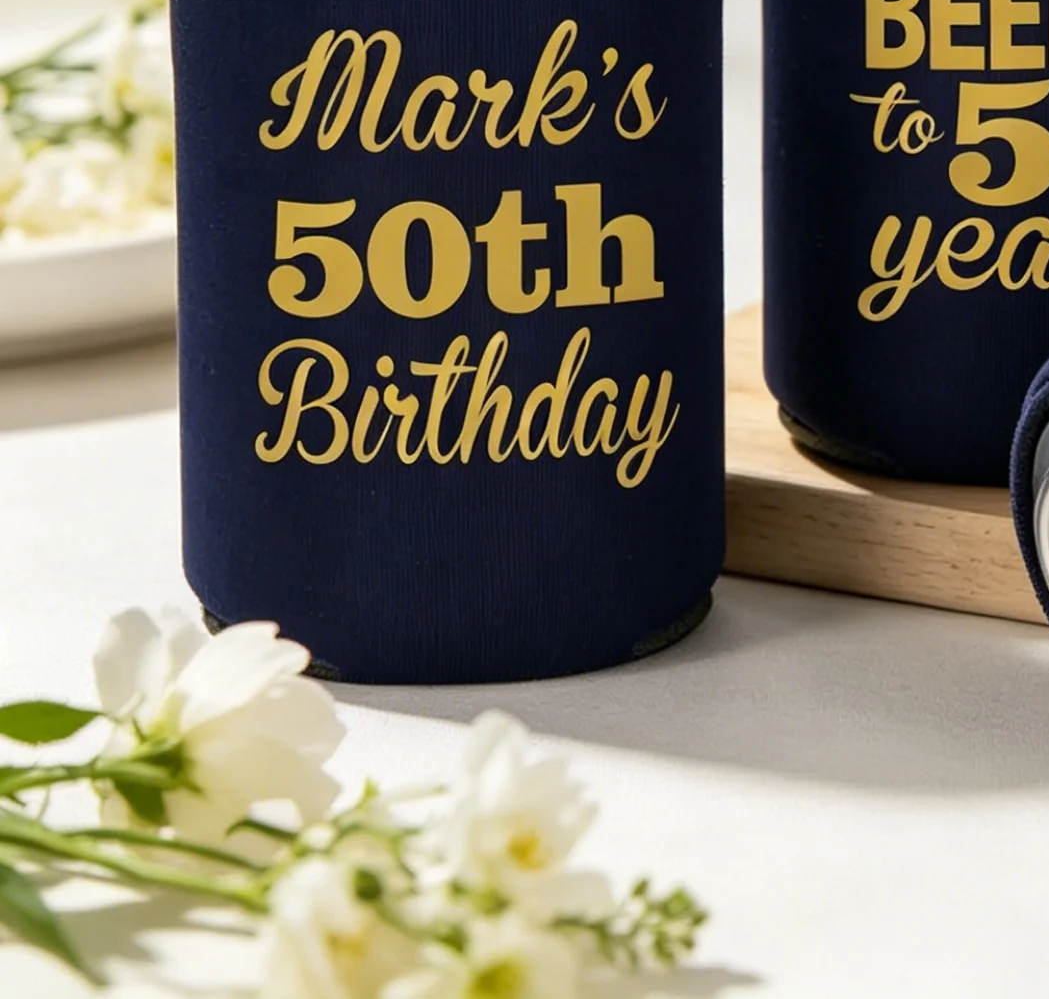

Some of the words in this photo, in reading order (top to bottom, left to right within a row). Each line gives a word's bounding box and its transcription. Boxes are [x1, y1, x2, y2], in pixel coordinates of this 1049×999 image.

[258, 19, 667, 152] Mark's
[849, 80, 944, 155] to
[268, 182, 665, 319] 50th
[254, 327, 680, 489] Birthday
